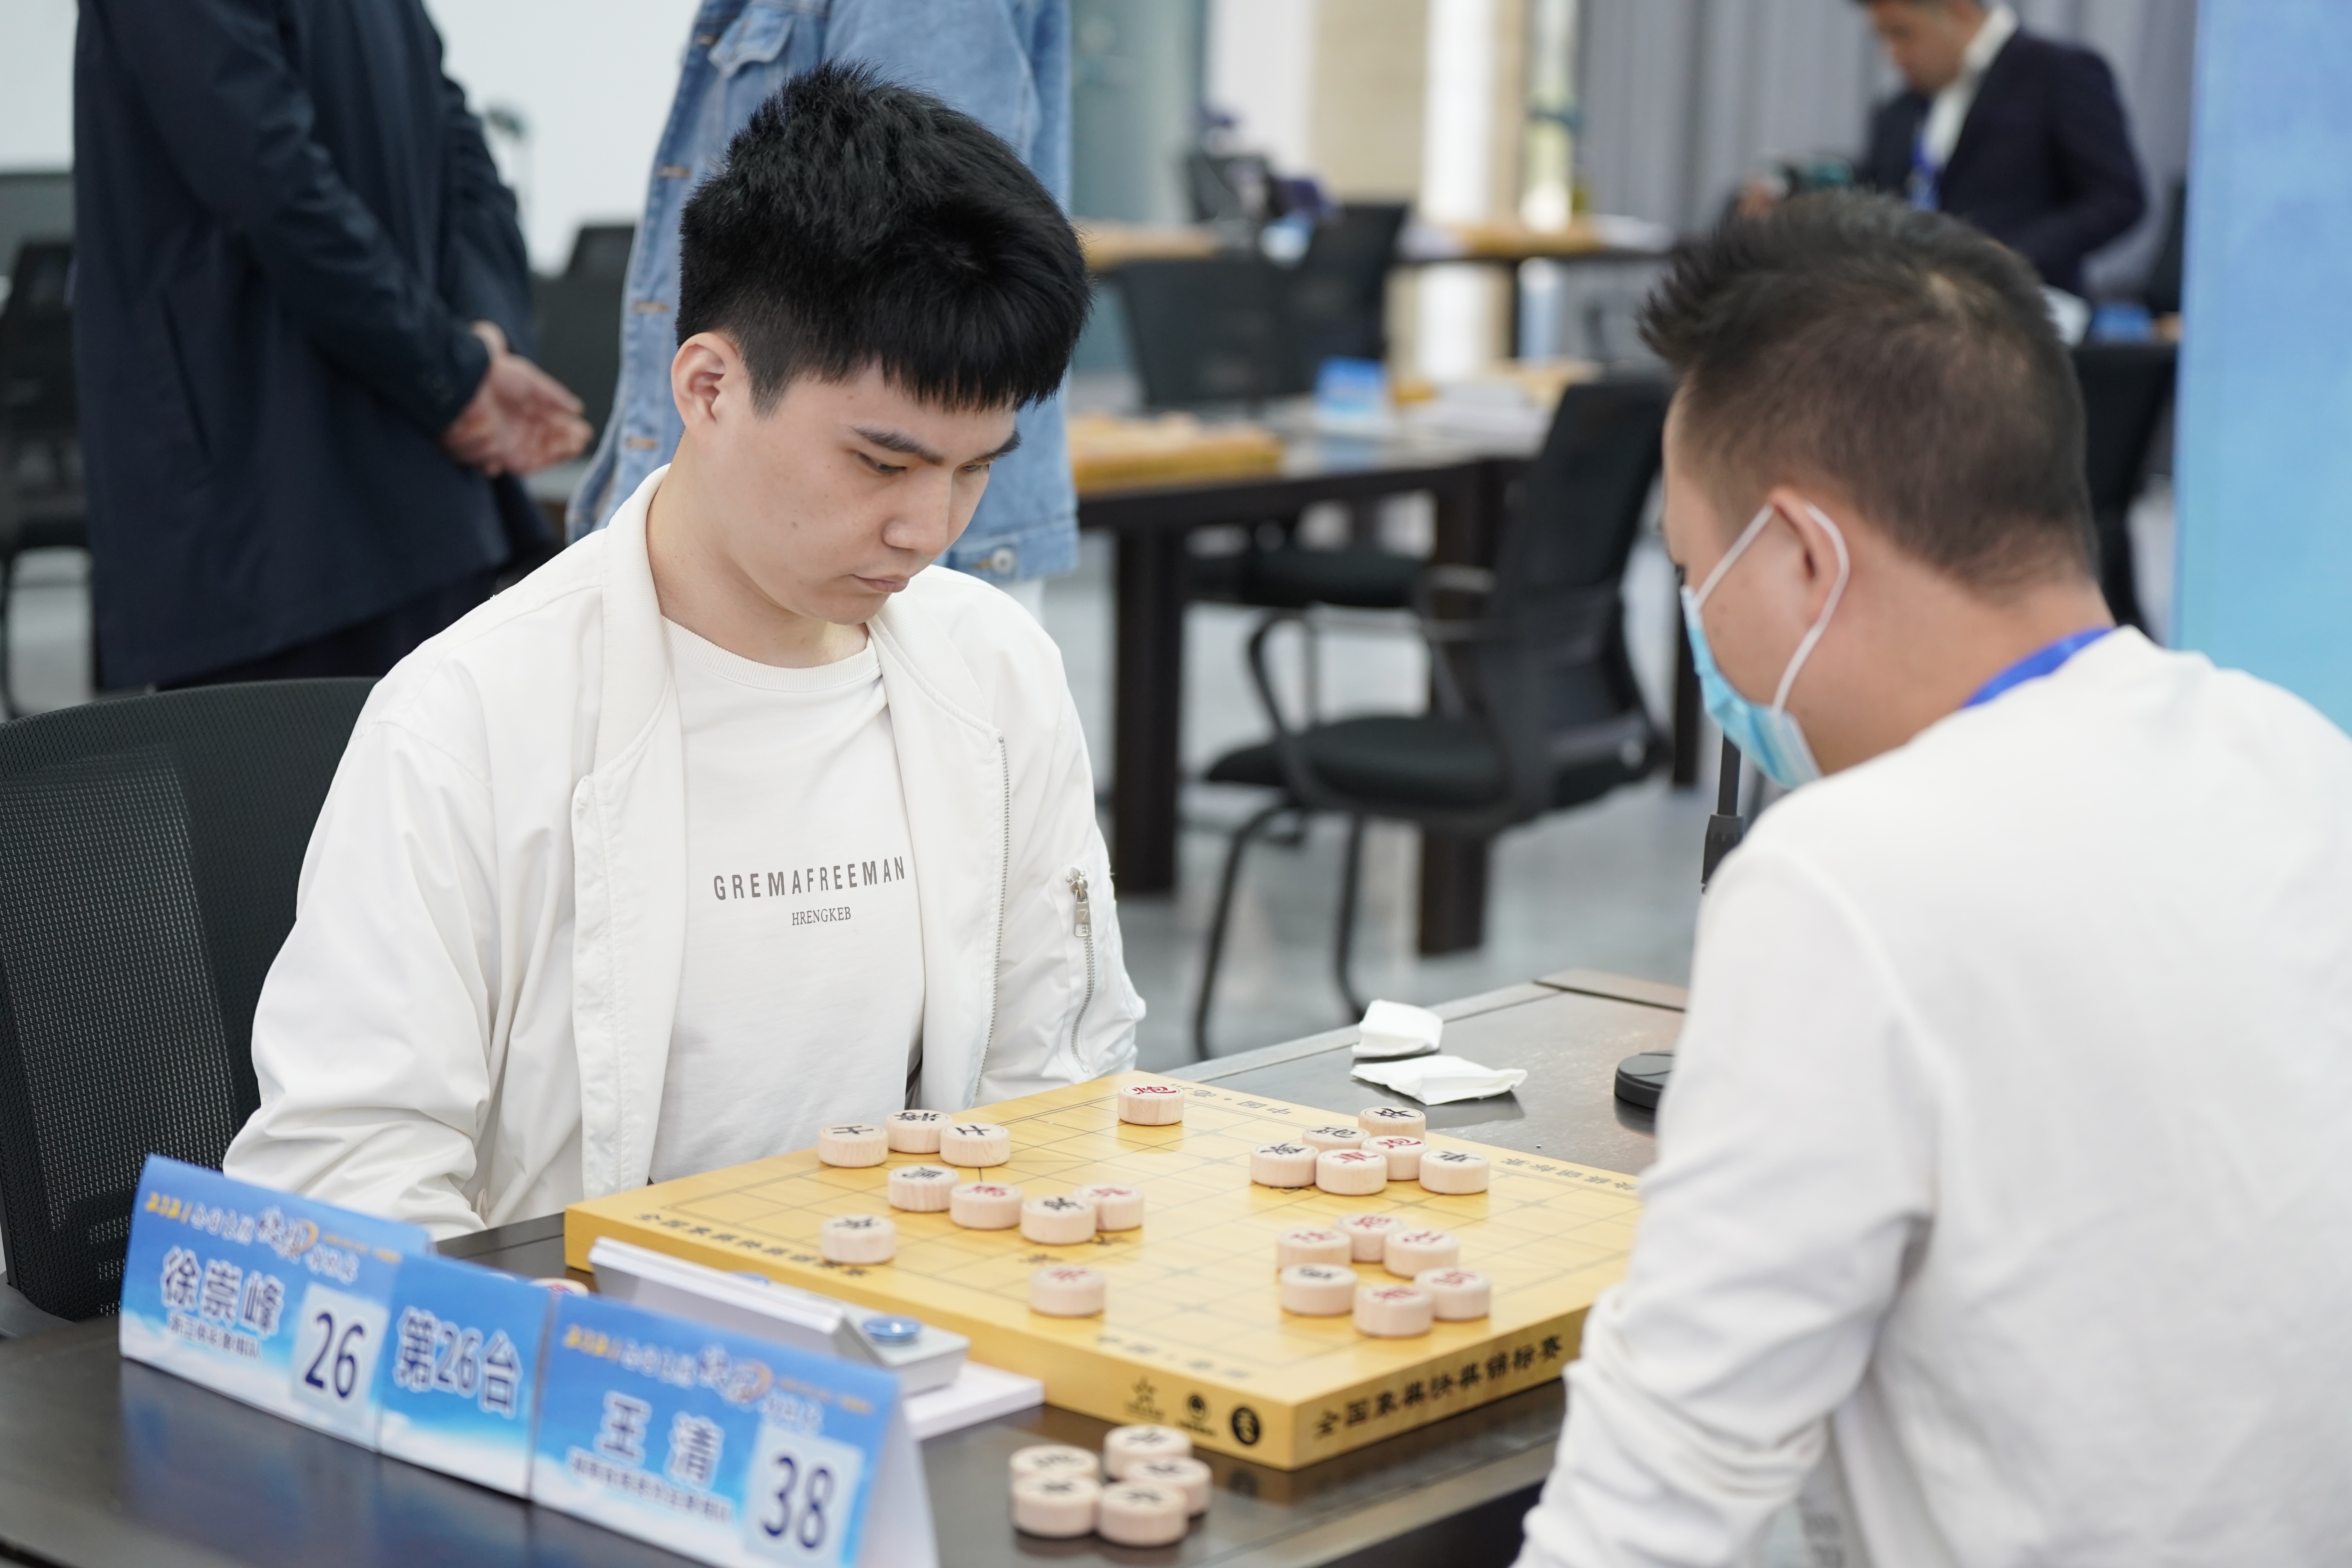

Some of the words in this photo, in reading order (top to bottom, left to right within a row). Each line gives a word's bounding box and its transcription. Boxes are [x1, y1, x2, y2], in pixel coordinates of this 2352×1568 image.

[713, 856, 905, 900] GREMAFREEMAN
[791, 906, 852, 926] HRENGKEB
[1132, 1085, 1177, 1095] 炮
[831, 1125, 874, 1135] 士
[956, 1125, 991, 1136] 士
[162, 1247, 284, 1334] 徐崇峰
[305, 1311, 367, 1399] 26
[396, 1308, 518, 1415] 第26台
[762, 1456, 835, 1548] 38
